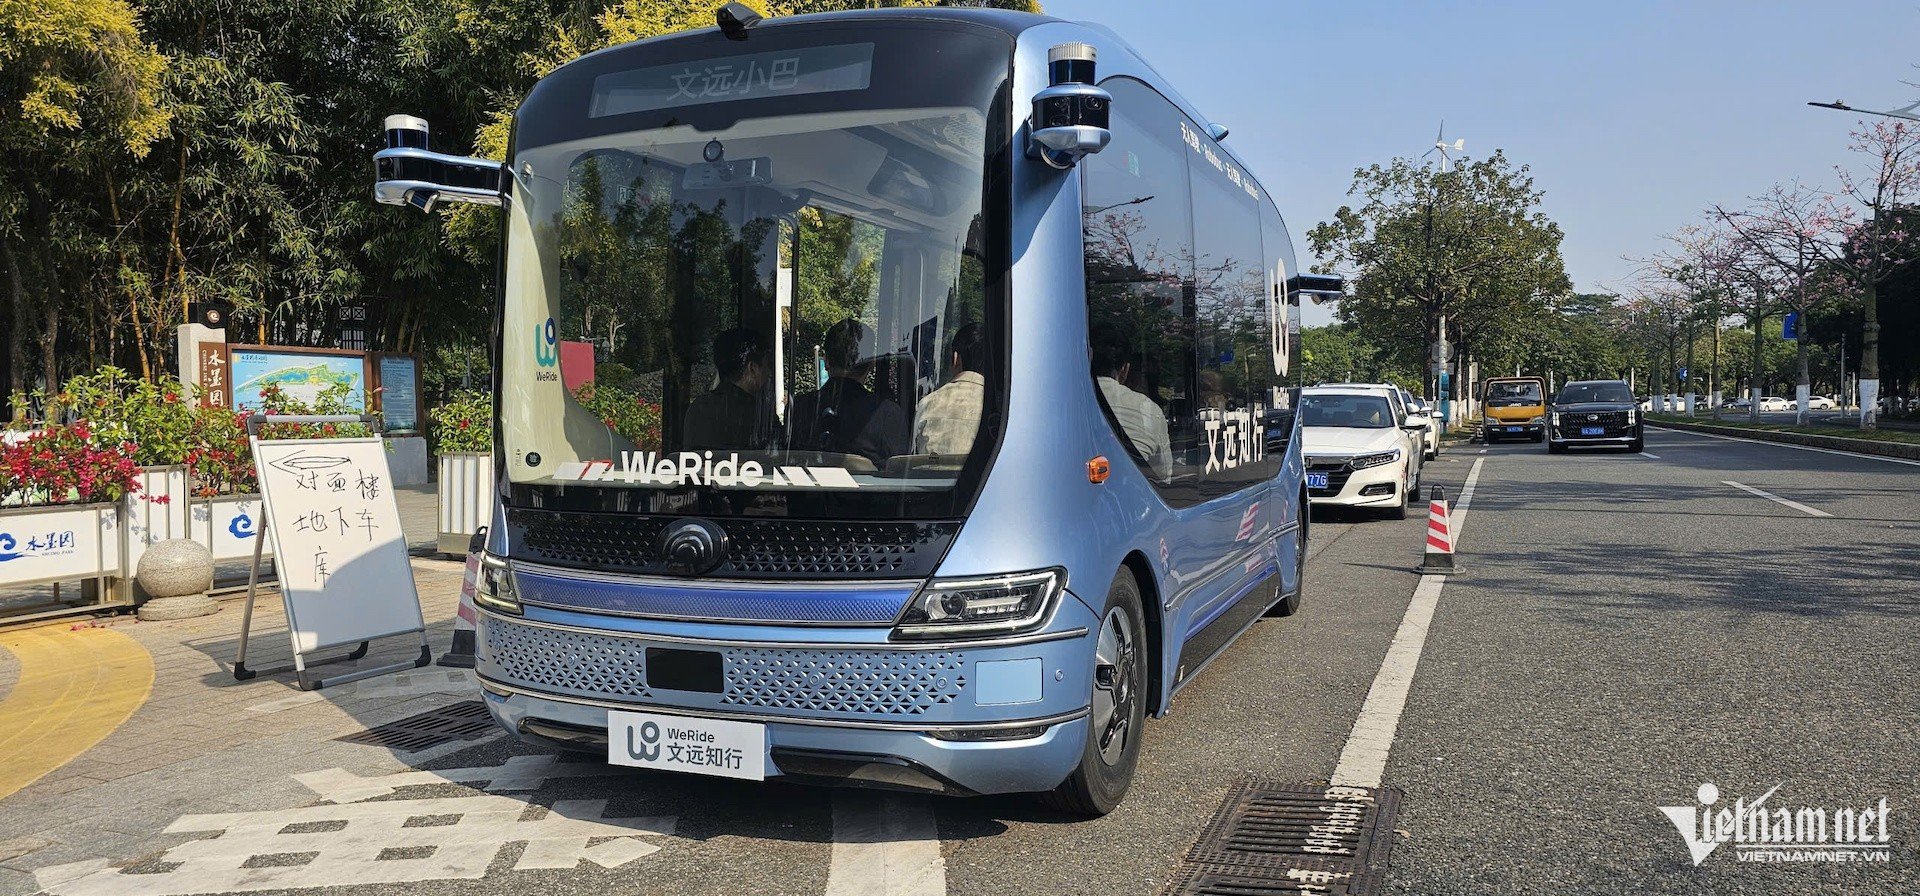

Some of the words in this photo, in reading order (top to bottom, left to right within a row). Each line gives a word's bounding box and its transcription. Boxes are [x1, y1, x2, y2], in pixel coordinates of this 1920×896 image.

[666, 57, 800, 101] 文远小巴
[536, 371, 558, 382] WeRide
[1205, 403, 1264, 475] 文远知行
[296, 469, 380, 500] 对面楼
[621, 450, 763, 487] WeRide
[292, 506, 379, 541] 地下车
[314, 545, 331, 588] 库
[667, 728, 715, 743] WeRide
[667, 743, 743, 769] 文远知行
